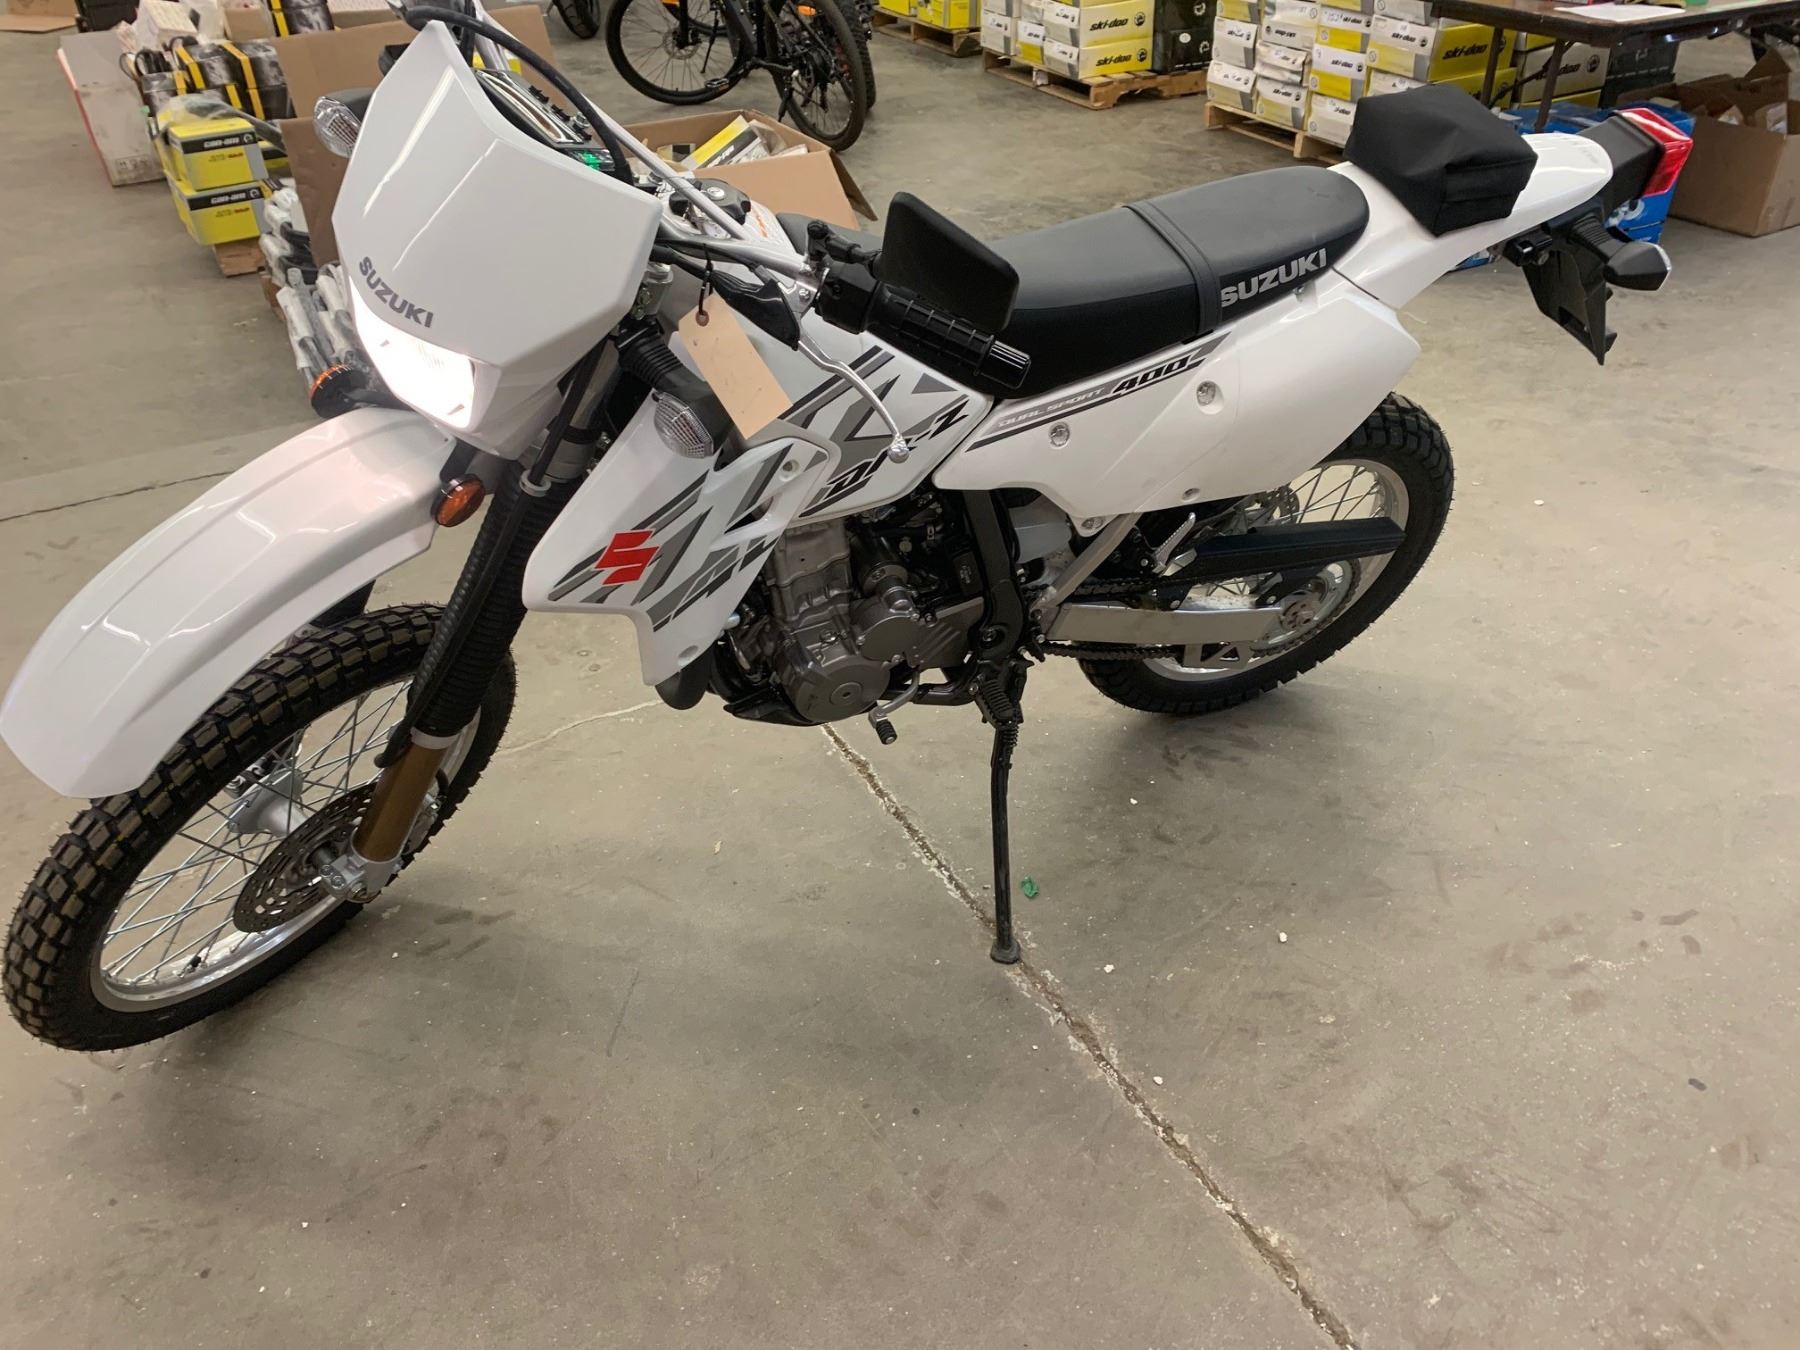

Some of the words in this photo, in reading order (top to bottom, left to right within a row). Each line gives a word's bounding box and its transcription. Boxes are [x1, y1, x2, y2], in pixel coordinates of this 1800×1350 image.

[1089, 17, 1129, 32] ski-doo
[1095, 53, 1132, 67] ski-doo
[1442, 43, 1488, 60] ski-doo
[358, 255, 435, 329] SUZUKI
[1220, 247, 1328, 308] SUZUKI
[999, 410, 1043, 428] DUAL
[1047, 387, 1105, 412] SPORT
[1110, 354, 1194, 395] 400
